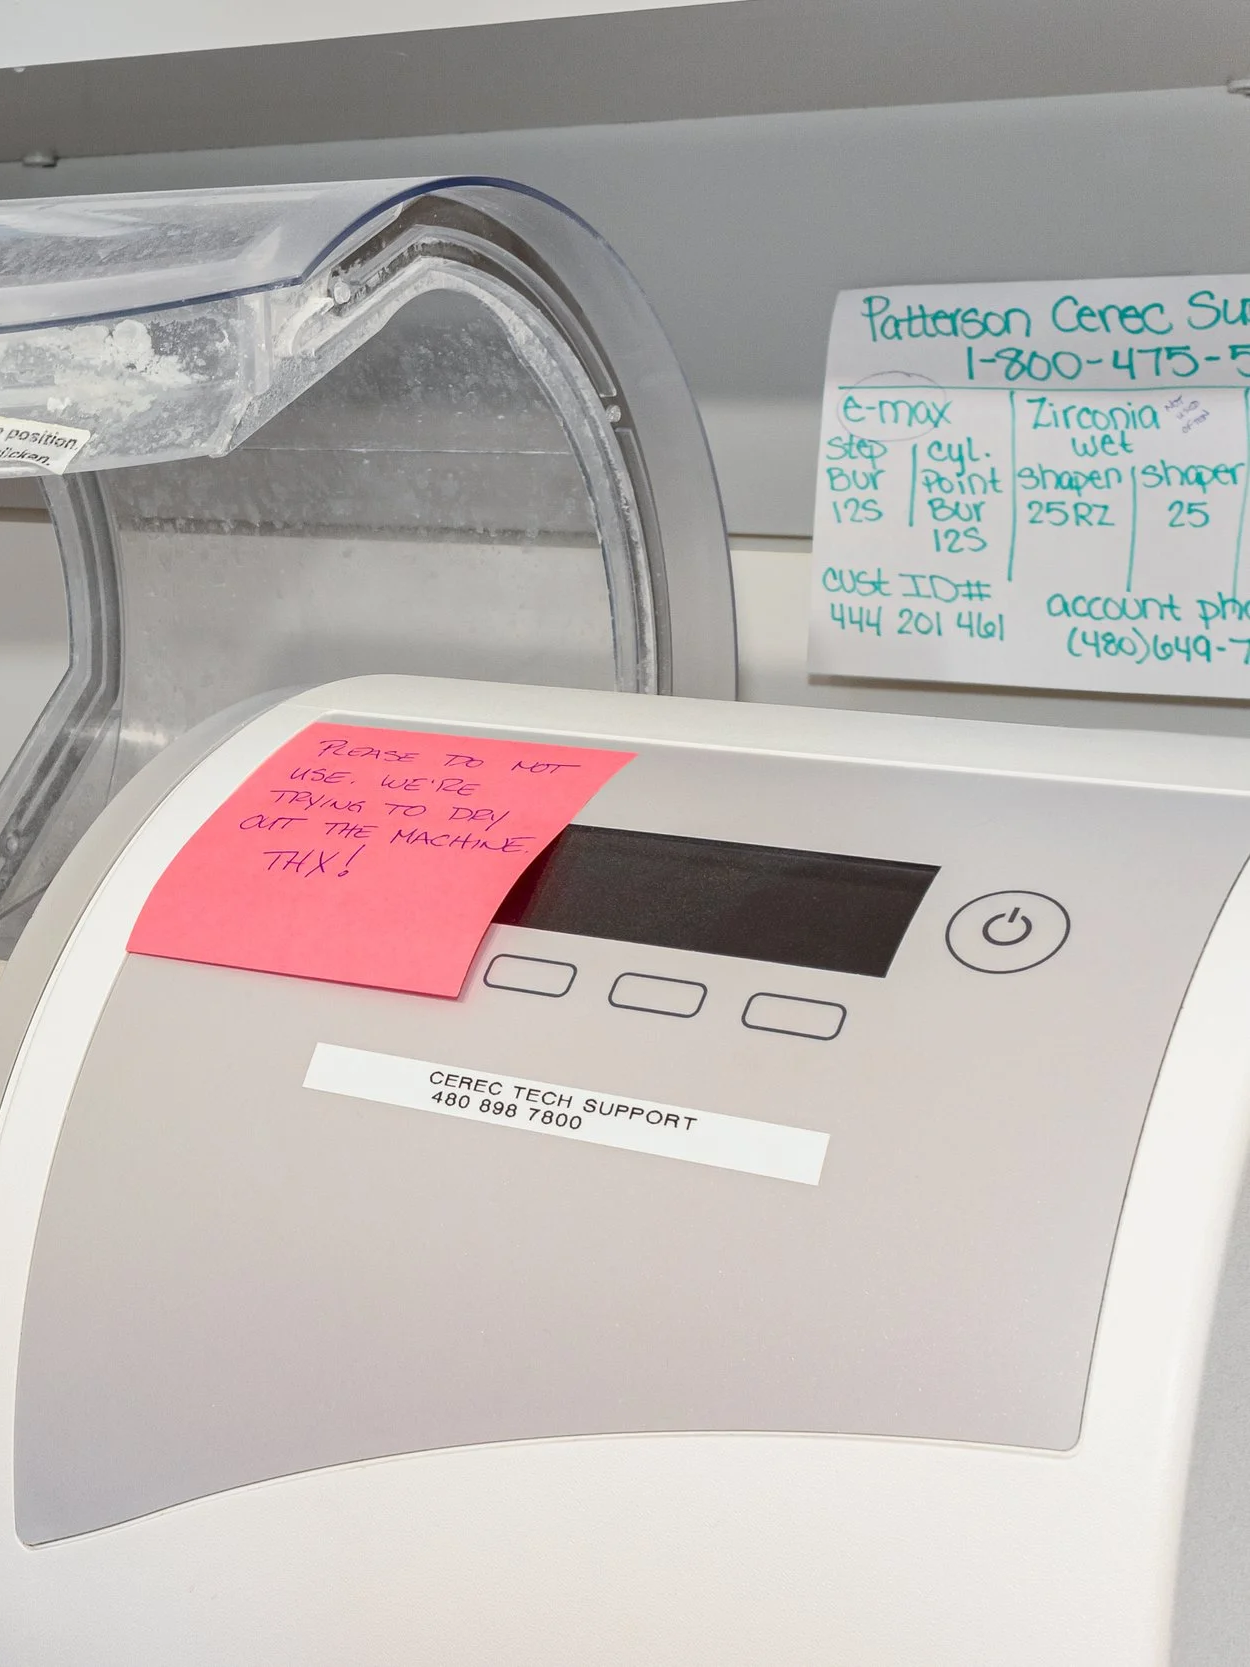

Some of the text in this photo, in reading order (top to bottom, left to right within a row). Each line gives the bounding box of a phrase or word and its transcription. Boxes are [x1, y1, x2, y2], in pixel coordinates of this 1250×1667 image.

[862, 295, 1032, 342] Patterson
[1051, 294, 1173, 335] Cerec
[842, 396, 952, 428] e-max
[1026, 397, 1160, 430] Zirconia
[827, 467, 885, 492] Bur
[921, 467, 1004, 495] Point
[927, 497, 986, 523] Bur
[1168, 500, 1210, 528] 25
[899, 573, 992, 602] ID#
[830, 603, 1005, 641] 444 201 461
[1046, 590, 1250, 630] account ph
[318, 739, 582, 776] PLEASE DO NOT
[381, 775, 482, 797] WE'RE
[238, 812, 309, 831] OUT
[325, 822, 379, 840] THE
[270, 790, 510, 831] TRYING TO DRY
[262, 843, 366, 879] THX!
[428, 1070, 699, 1131] CEREC TECH SUPPORT
[429, 1090, 583, 1132] 480 898 7800
